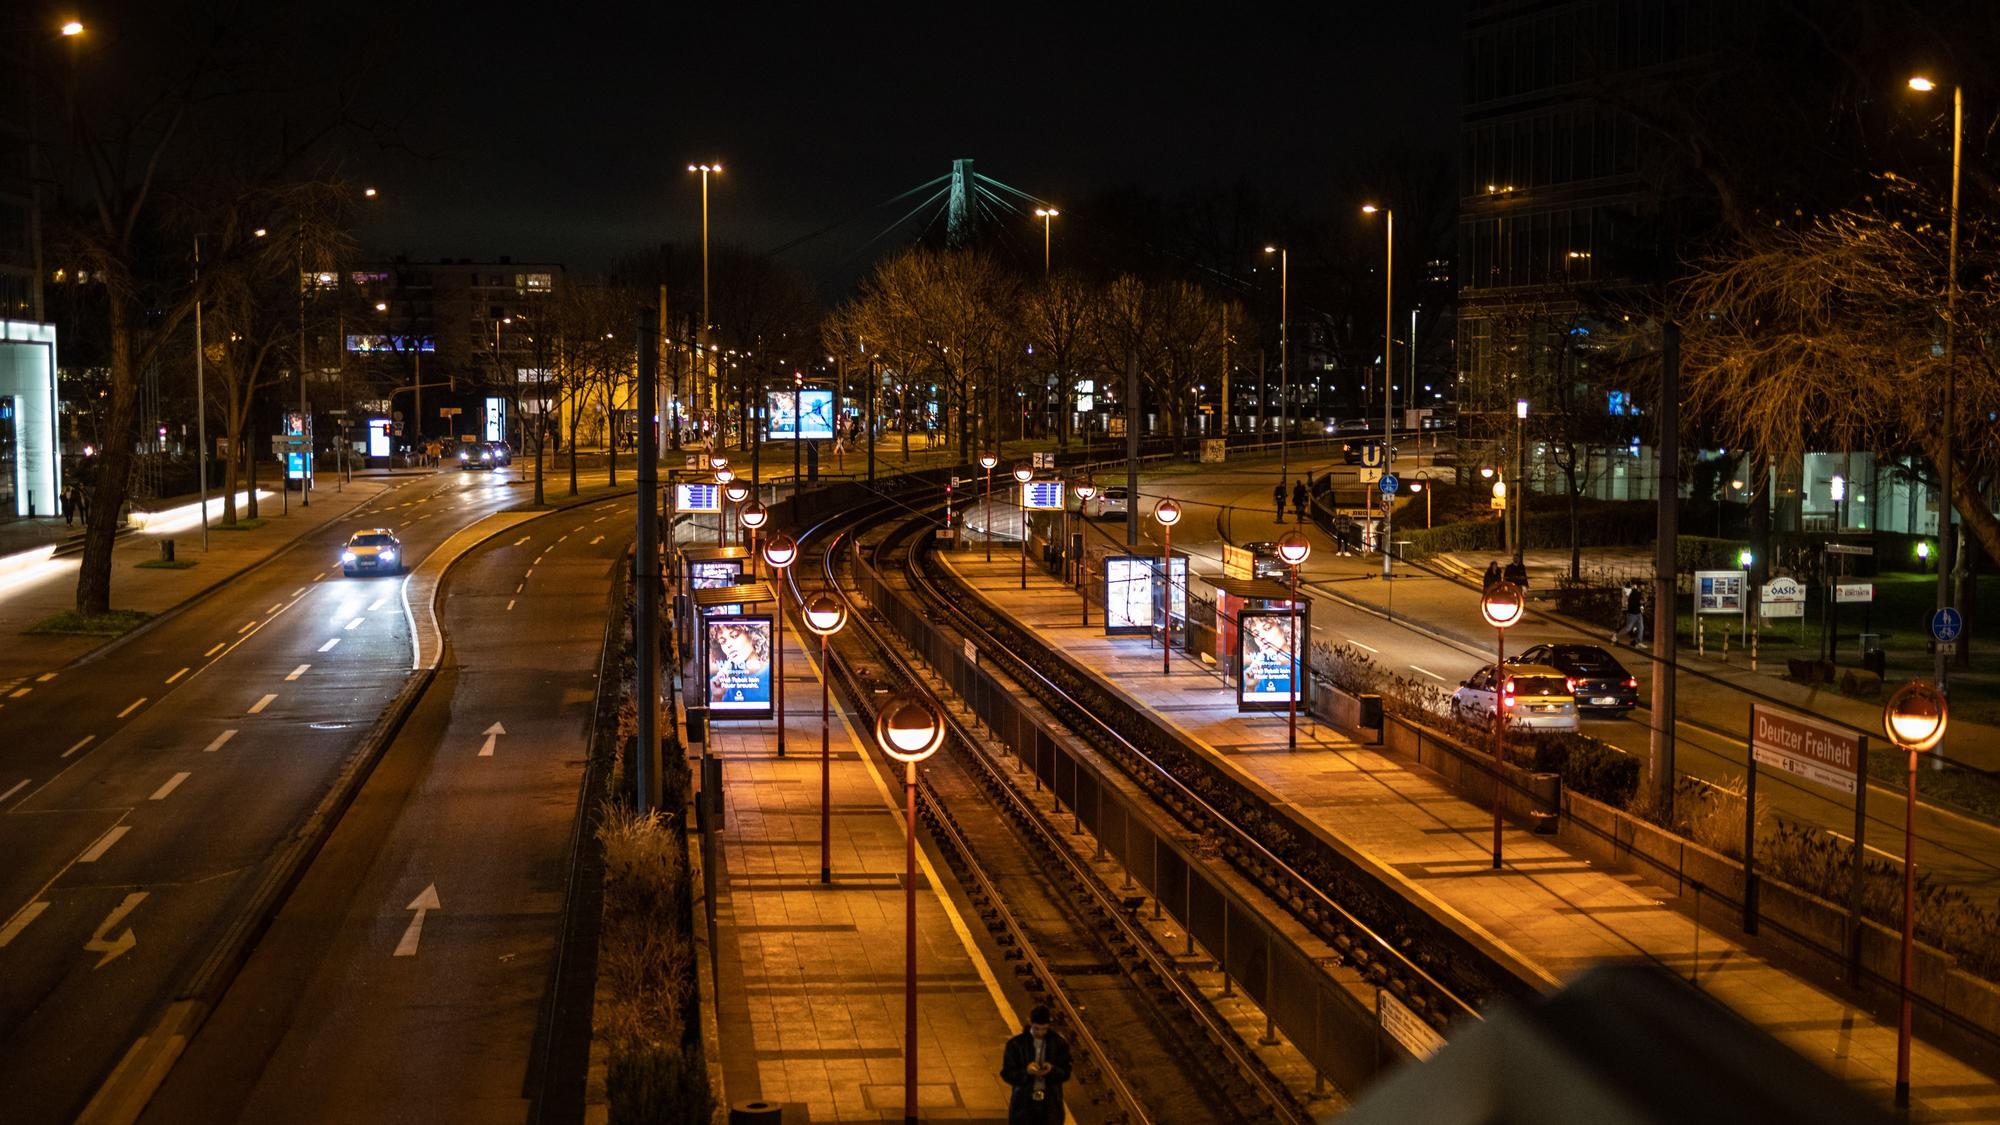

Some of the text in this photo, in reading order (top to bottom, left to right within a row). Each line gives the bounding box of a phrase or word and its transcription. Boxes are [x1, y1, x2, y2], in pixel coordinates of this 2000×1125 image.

[1363, 446, 1380, 466] U
[1771, 586, 1796, 595] OASIS
[1760, 716, 1851, 767] Deutzer Freiheit
